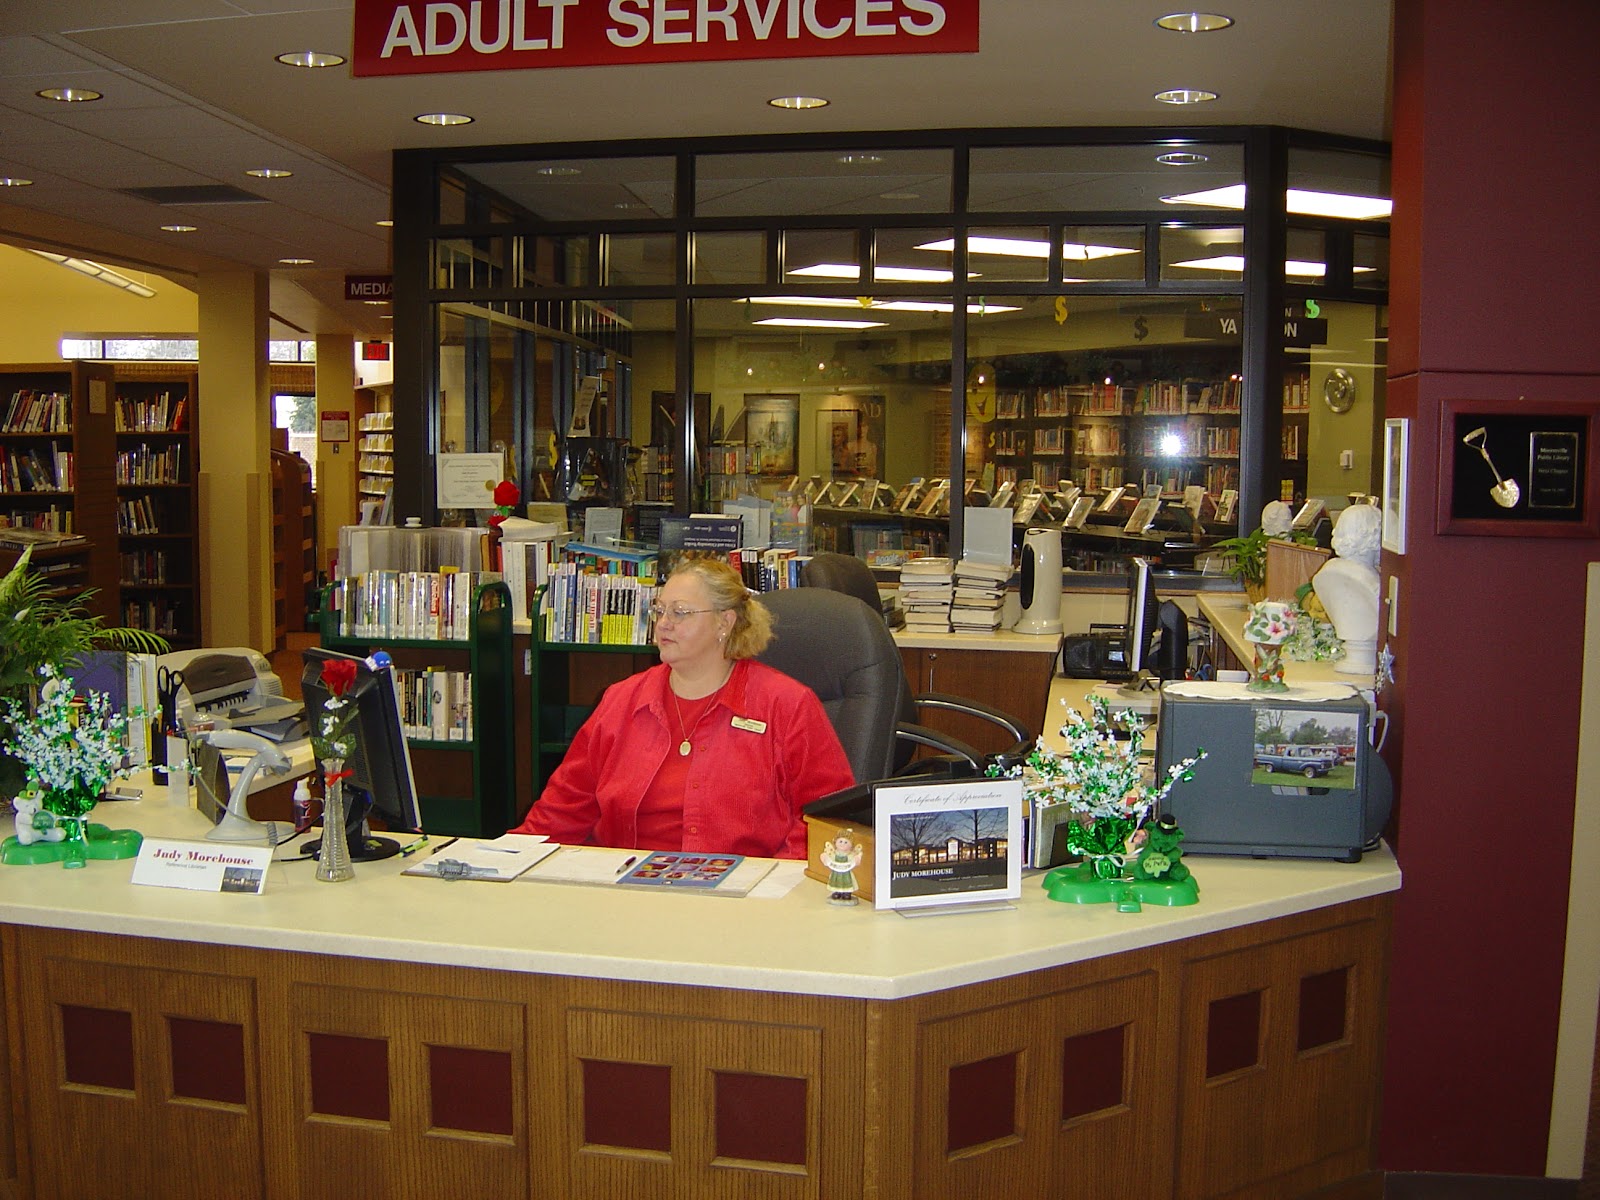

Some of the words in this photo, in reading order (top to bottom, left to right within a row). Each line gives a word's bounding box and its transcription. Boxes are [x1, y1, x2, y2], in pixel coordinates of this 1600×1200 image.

[380, 0, 579, 58] ADULT
[605, 0, 948, 48] SERVICES
[351, 283, 394, 295] MEDIA
[1220, 318, 1237, 335] YA
[904, 793, 942, 806] Certificate
[953, 791, 1002, 803] Appreciation
[153, 848, 183, 862] Judy
[186, 850, 254, 865] Morehouse
[892, 871, 911, 880] JUDY
[911, 868, 954, 877] MOREHOUSE
